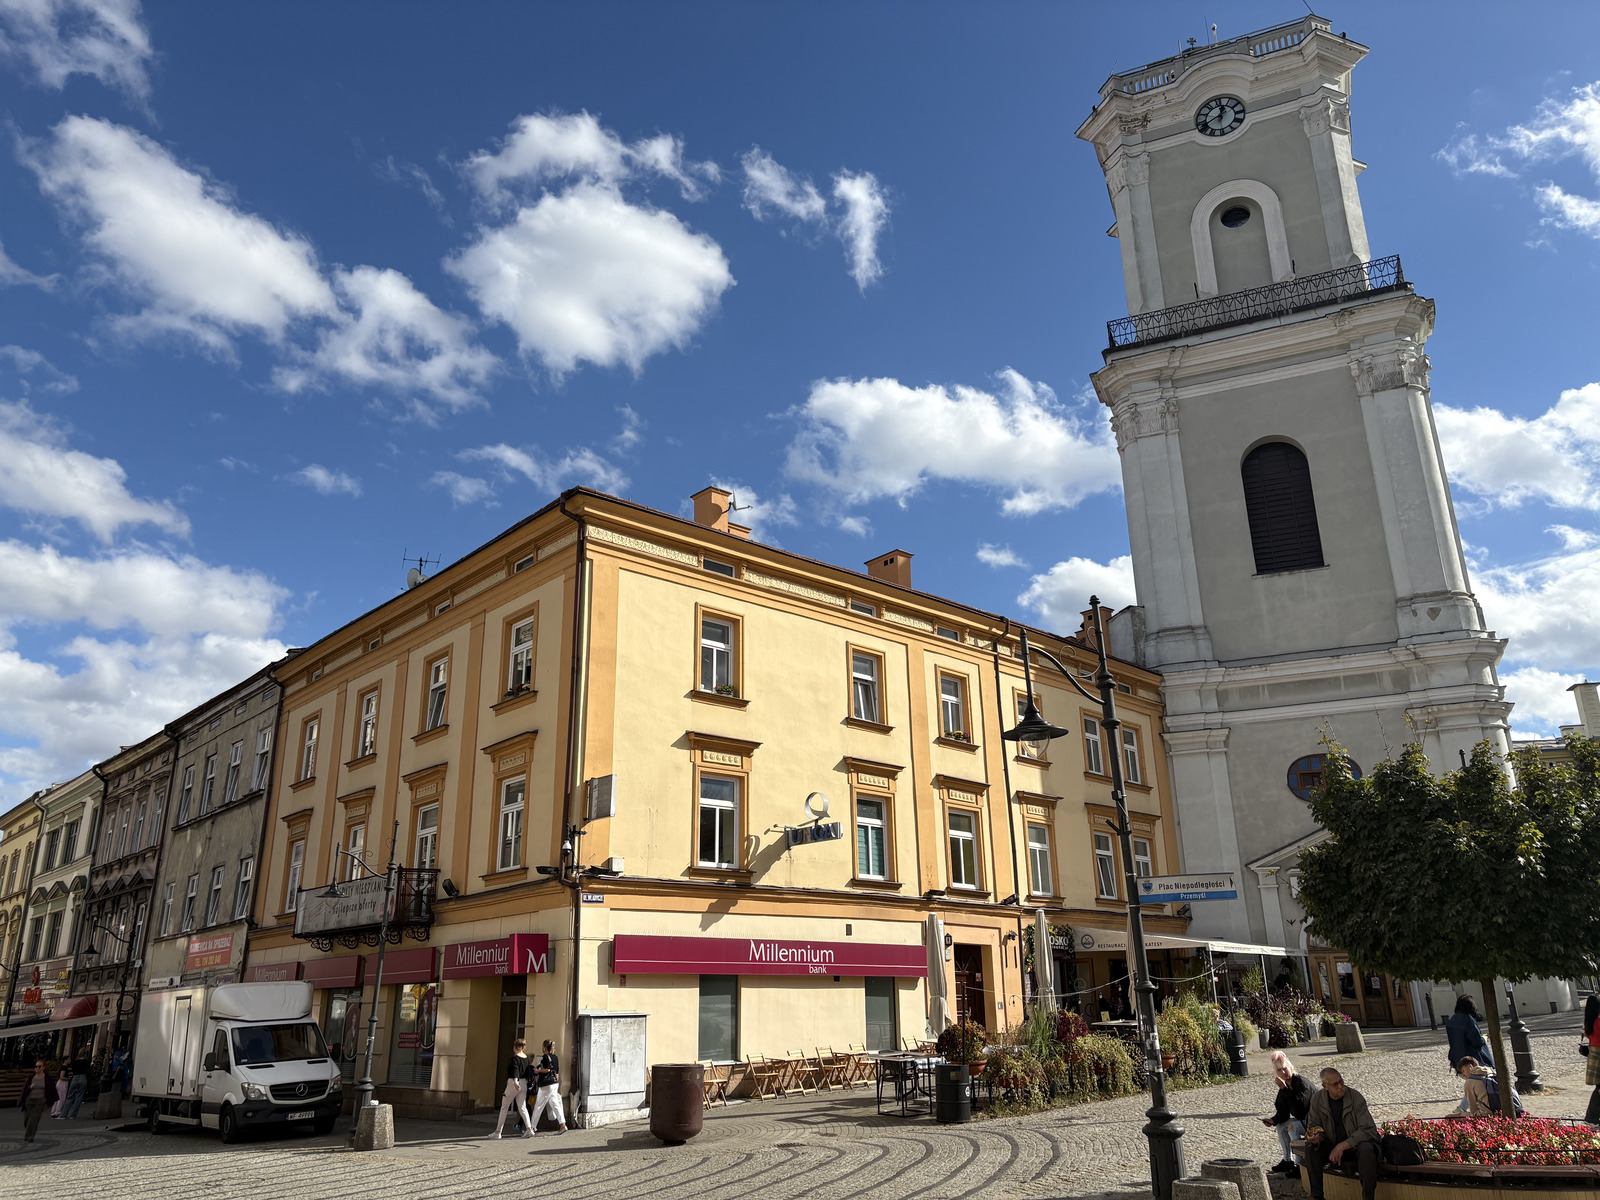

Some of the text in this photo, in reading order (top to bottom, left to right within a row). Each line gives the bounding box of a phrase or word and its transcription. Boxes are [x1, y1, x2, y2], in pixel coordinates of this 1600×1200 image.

[1158, 880, 1226, 891] Plac Niepodległości
[1049, 935, 1069, 946] OSKO
[749, 939, 835, 963] Millennium
[254, 967, 287, 982] Millennium
[808, 964, 827, 974] bank
